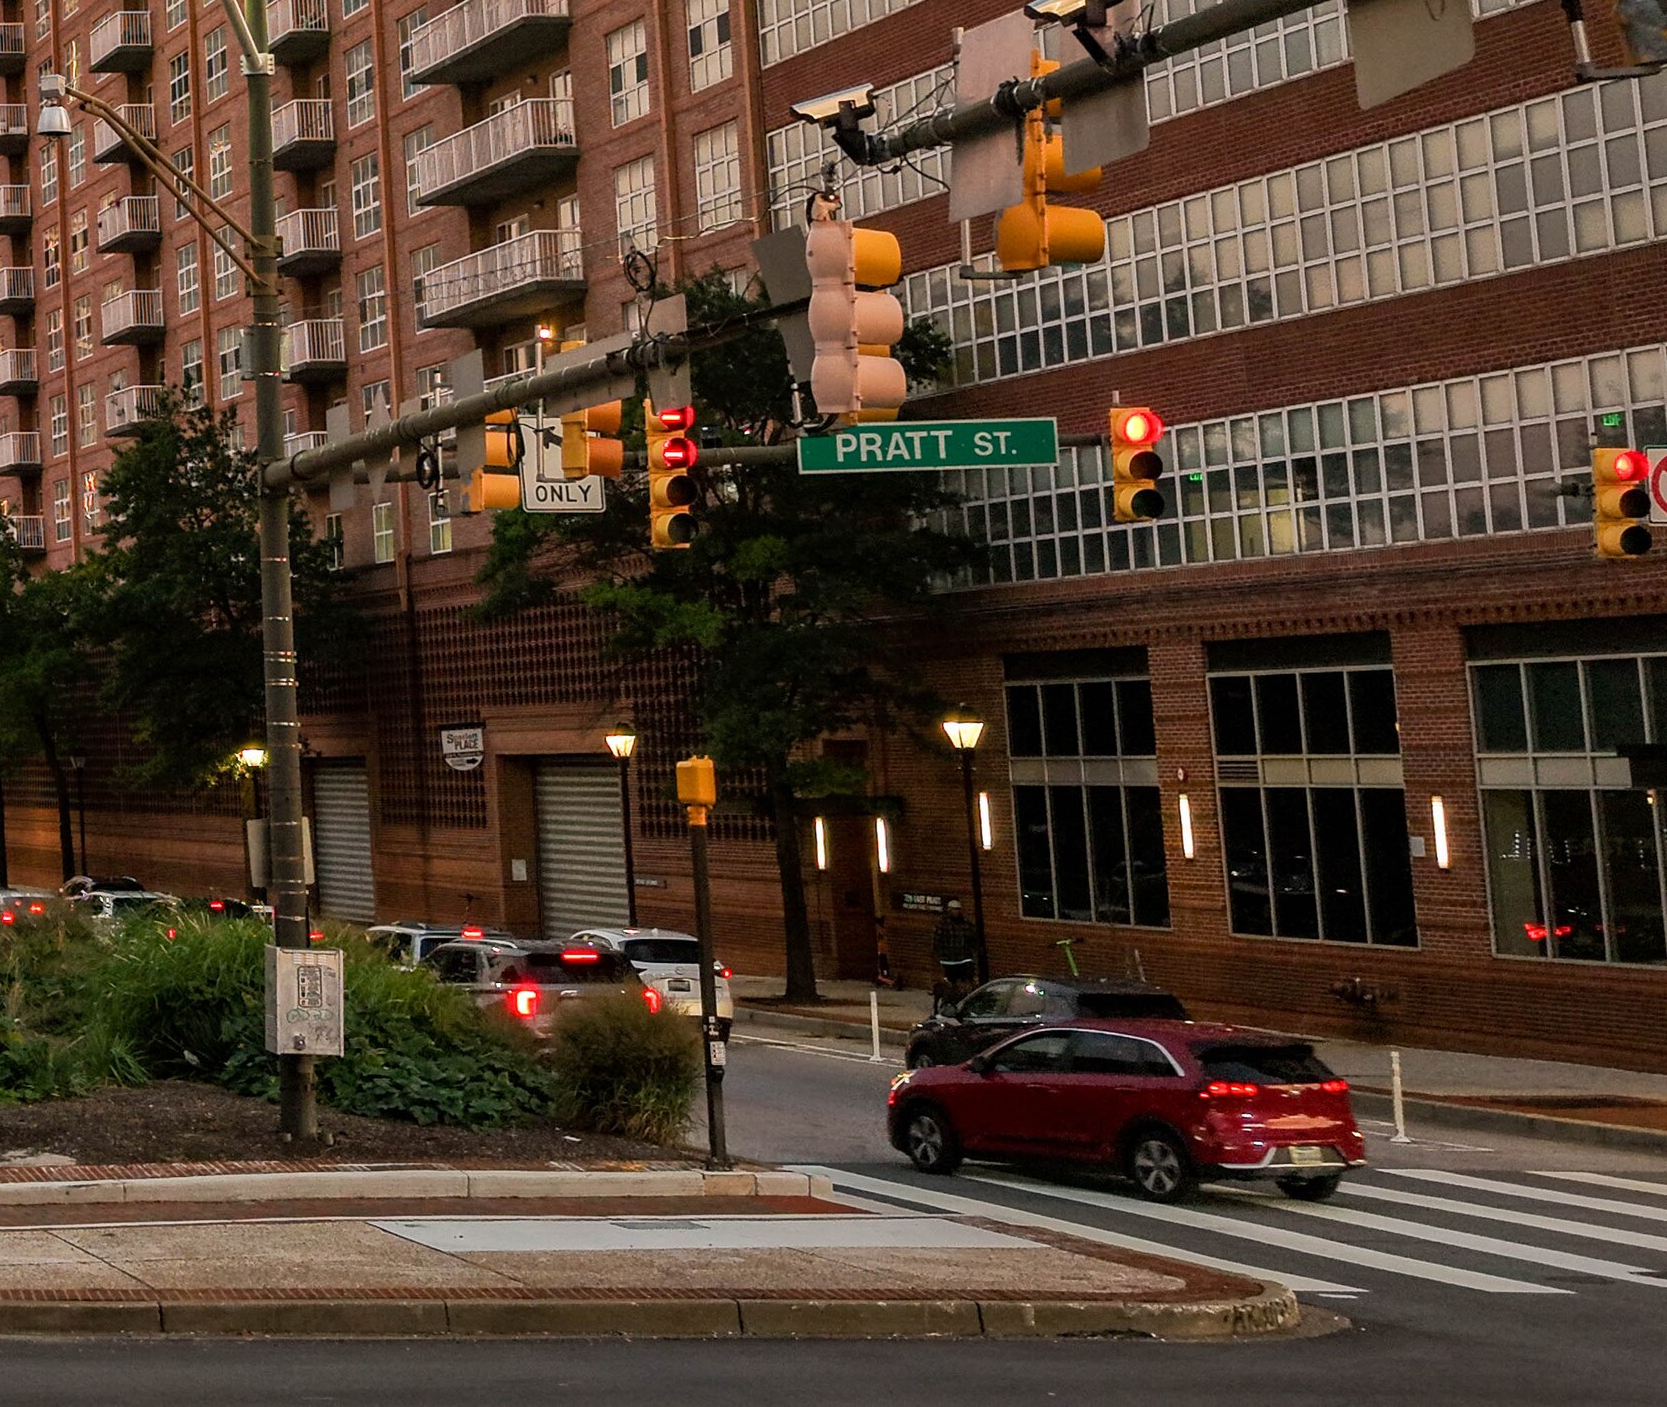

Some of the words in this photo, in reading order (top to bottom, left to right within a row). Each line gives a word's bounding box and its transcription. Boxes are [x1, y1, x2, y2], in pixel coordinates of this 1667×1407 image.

[835, 429, 953, 463] PRATT
[973, 431, 1018, 457] ST.
[535, 484, 592, 503] ONLY
[454, 739, 479, 750] PLACE
